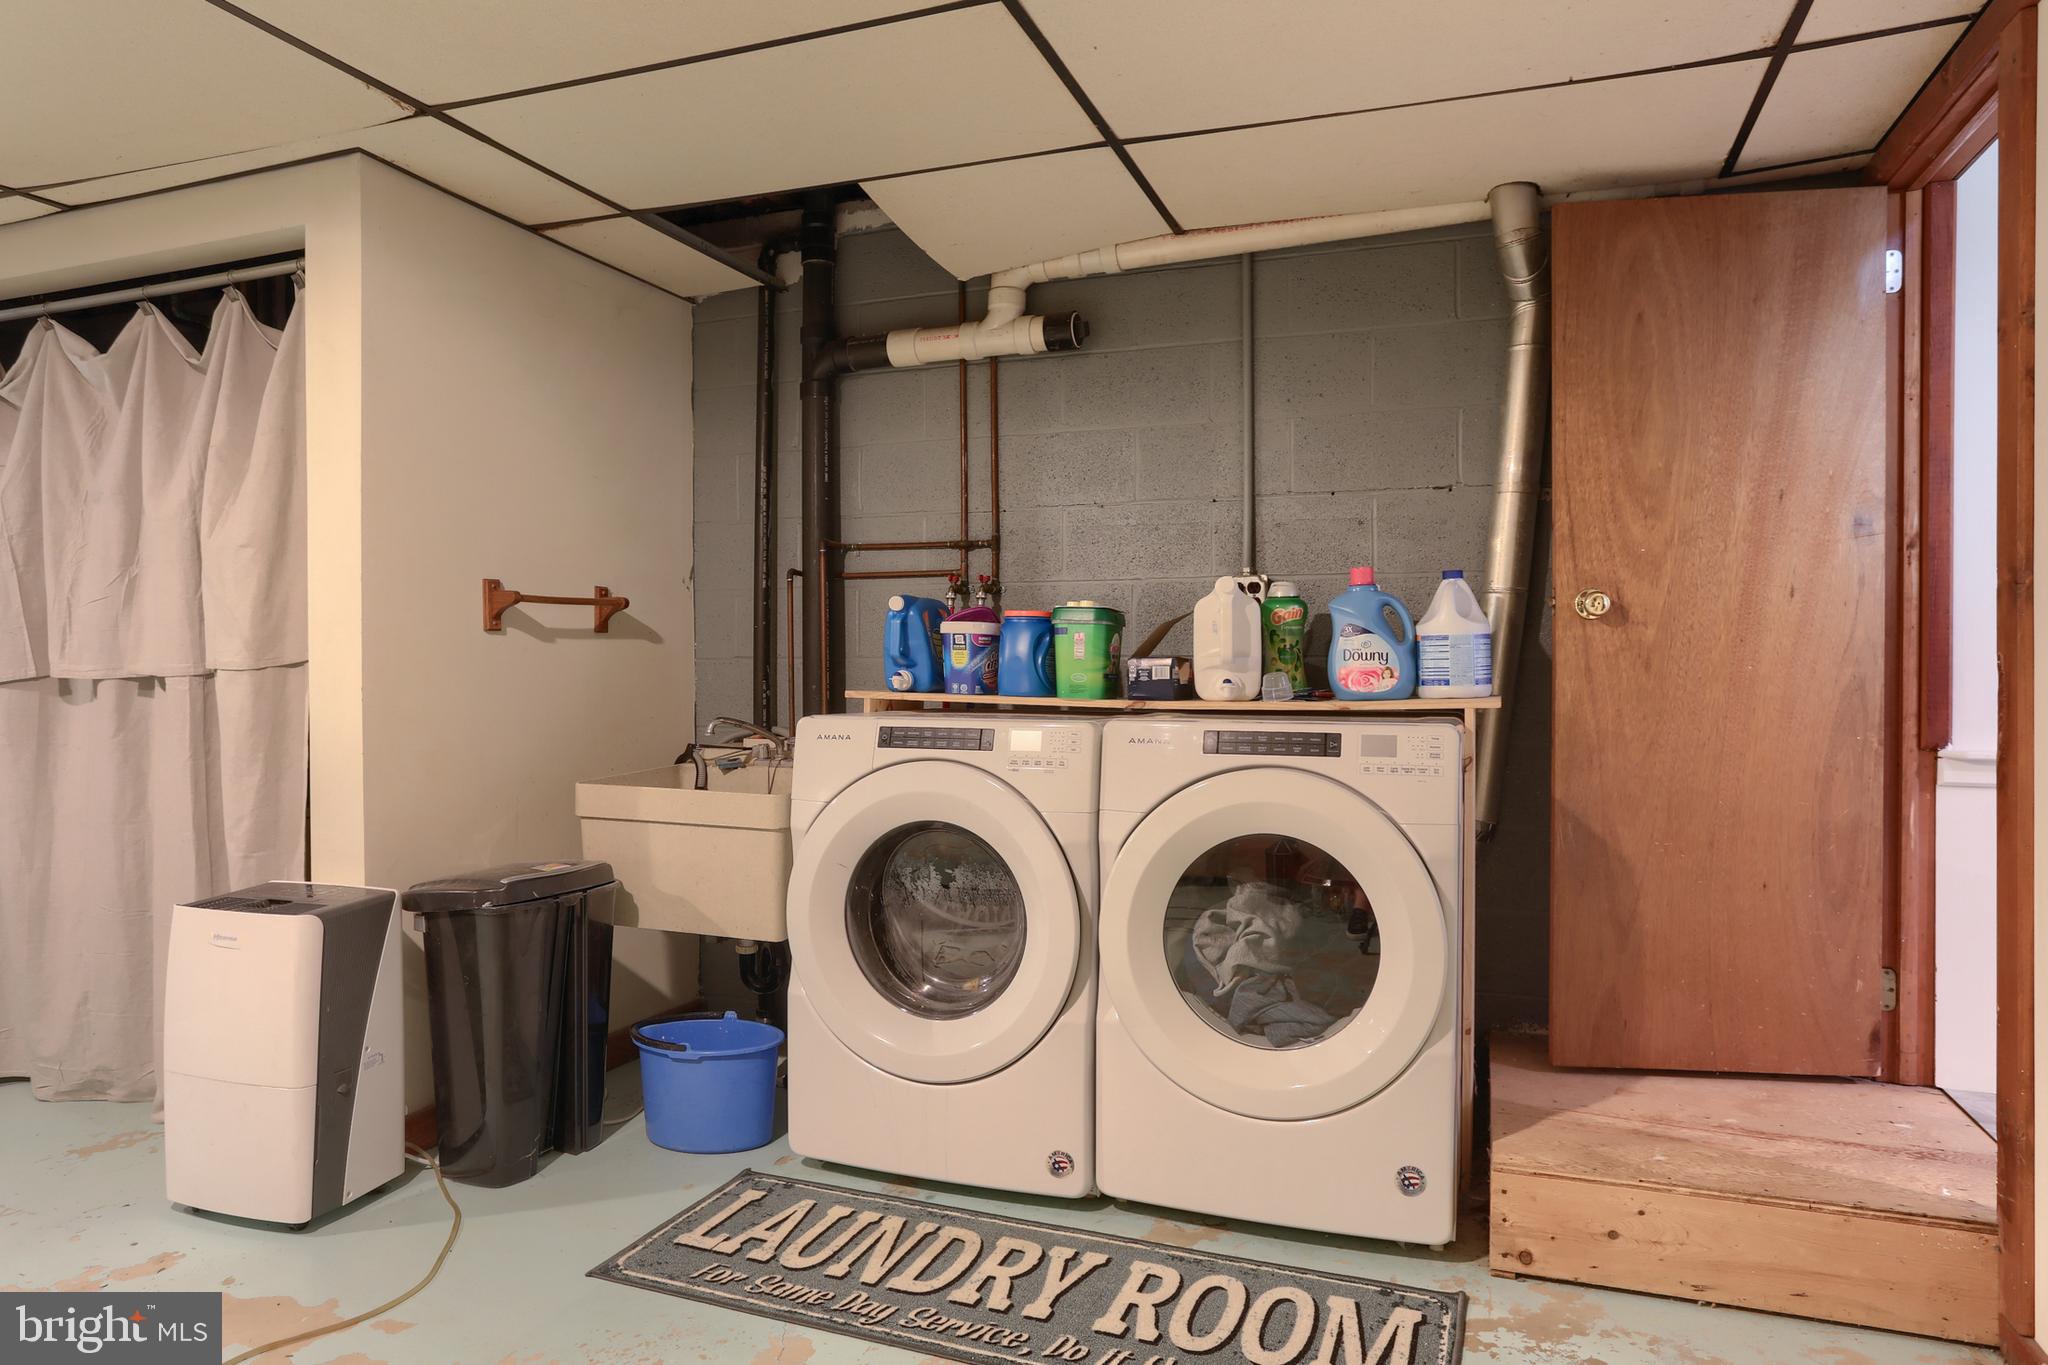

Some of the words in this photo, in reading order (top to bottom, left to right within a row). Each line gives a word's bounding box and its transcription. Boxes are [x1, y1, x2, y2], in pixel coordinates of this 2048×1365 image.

[1271, 607, 1304, 625] Gain
[1343, 648, 1389, 665] Downy
[674, 1188, 1109, 1321] LAUNDRY
[1092, 1260, 1425, 1365] ROOM
[690, 1263, 749, 1285] For
[745, 1275, 836, 1306] Same
[832, 1291, 899, 1325] Day
[898, 1307, 1033, 1357] Service,
[1042, 1334, 1092, 1362] Do
